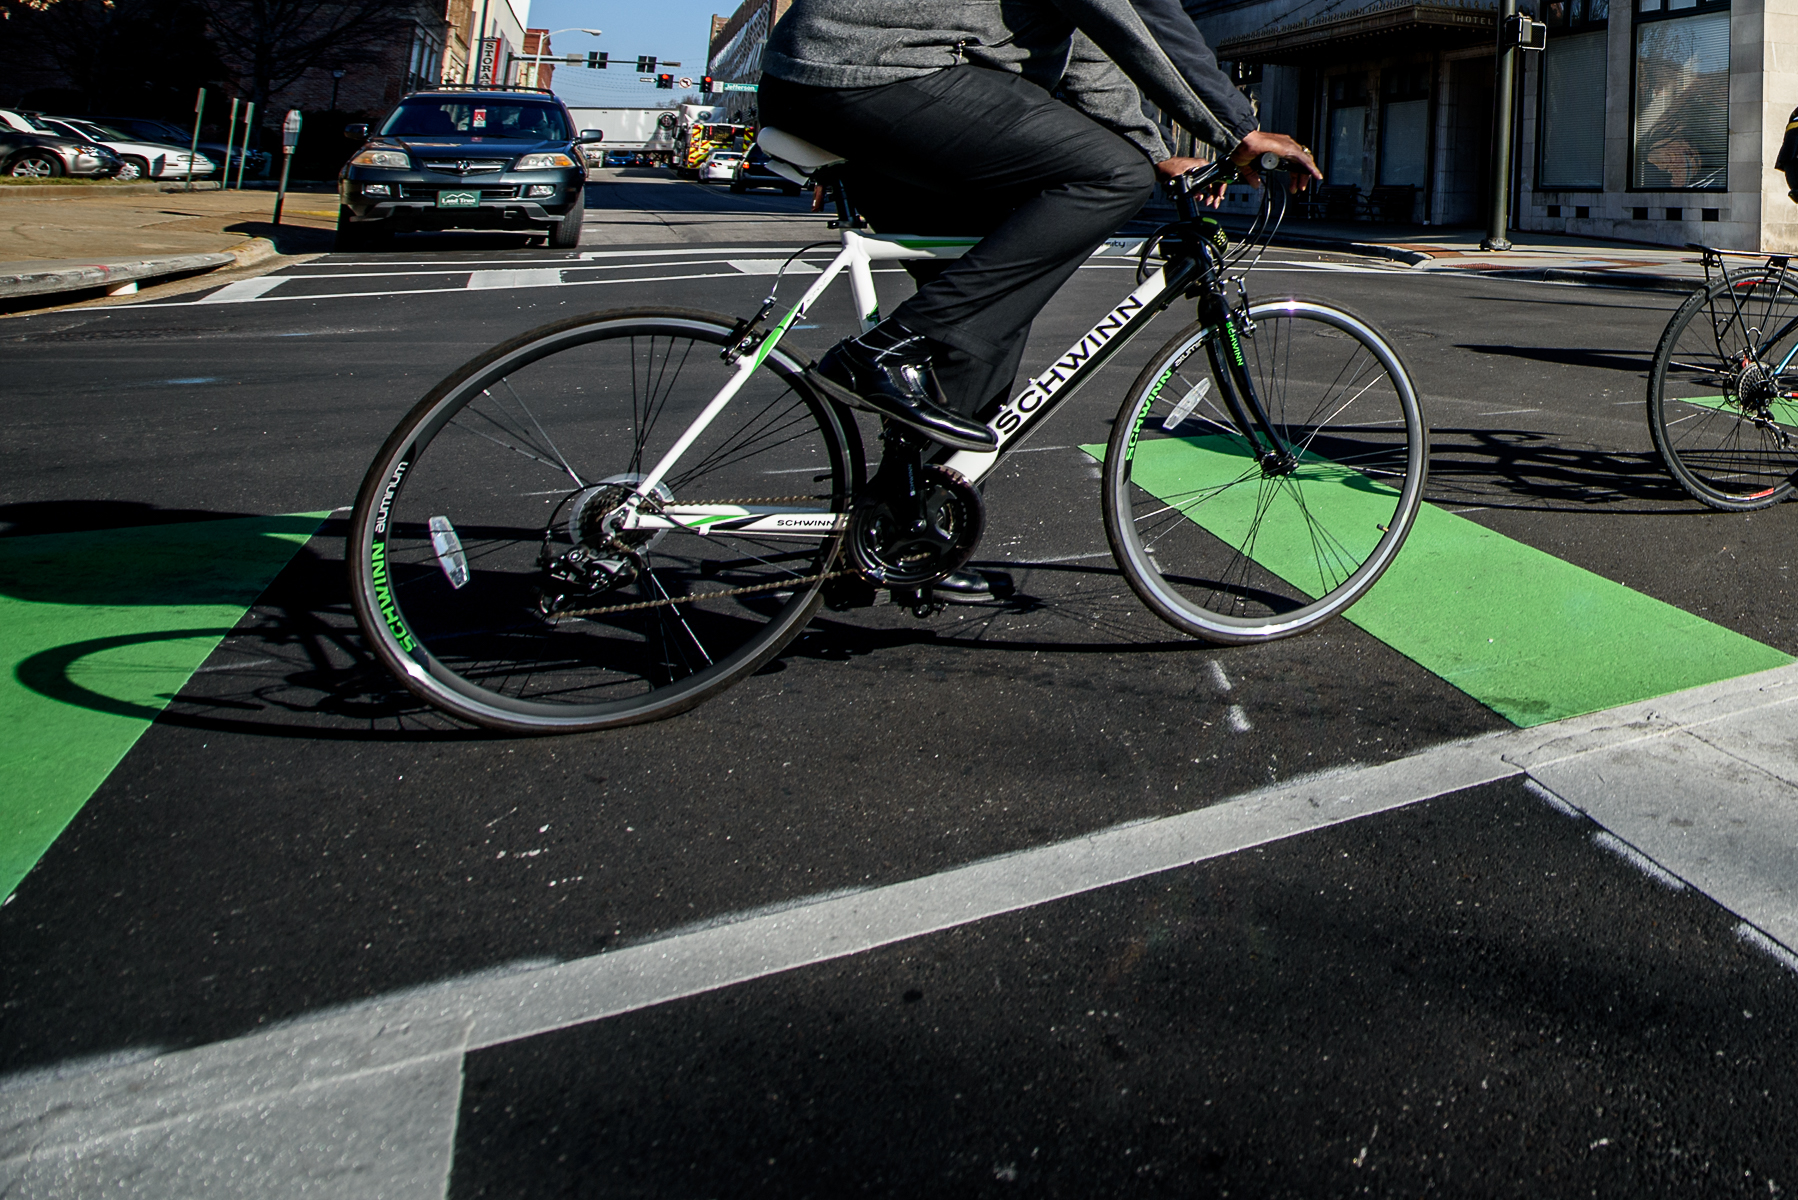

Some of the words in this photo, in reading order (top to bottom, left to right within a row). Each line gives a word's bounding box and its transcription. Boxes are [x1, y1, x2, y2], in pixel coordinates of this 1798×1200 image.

[1456, 14, 1494, 26] HOTEL
[480, 42, 495, 88] STORAG
[725, 82, 756, 91] Jefferson
[1104, 240, 1127, 249] sity
[995, 295, 1144, 436] SCHWINN
[1225, 321, 1244, 367] SCHWINN
[1125, 368, 1173, 461] SCHWINN
[375, 461, 409, 534] aluminum
[777, 519, 834, 527] SCHWINN
[371, 541, 418, 653] SCHWINN
